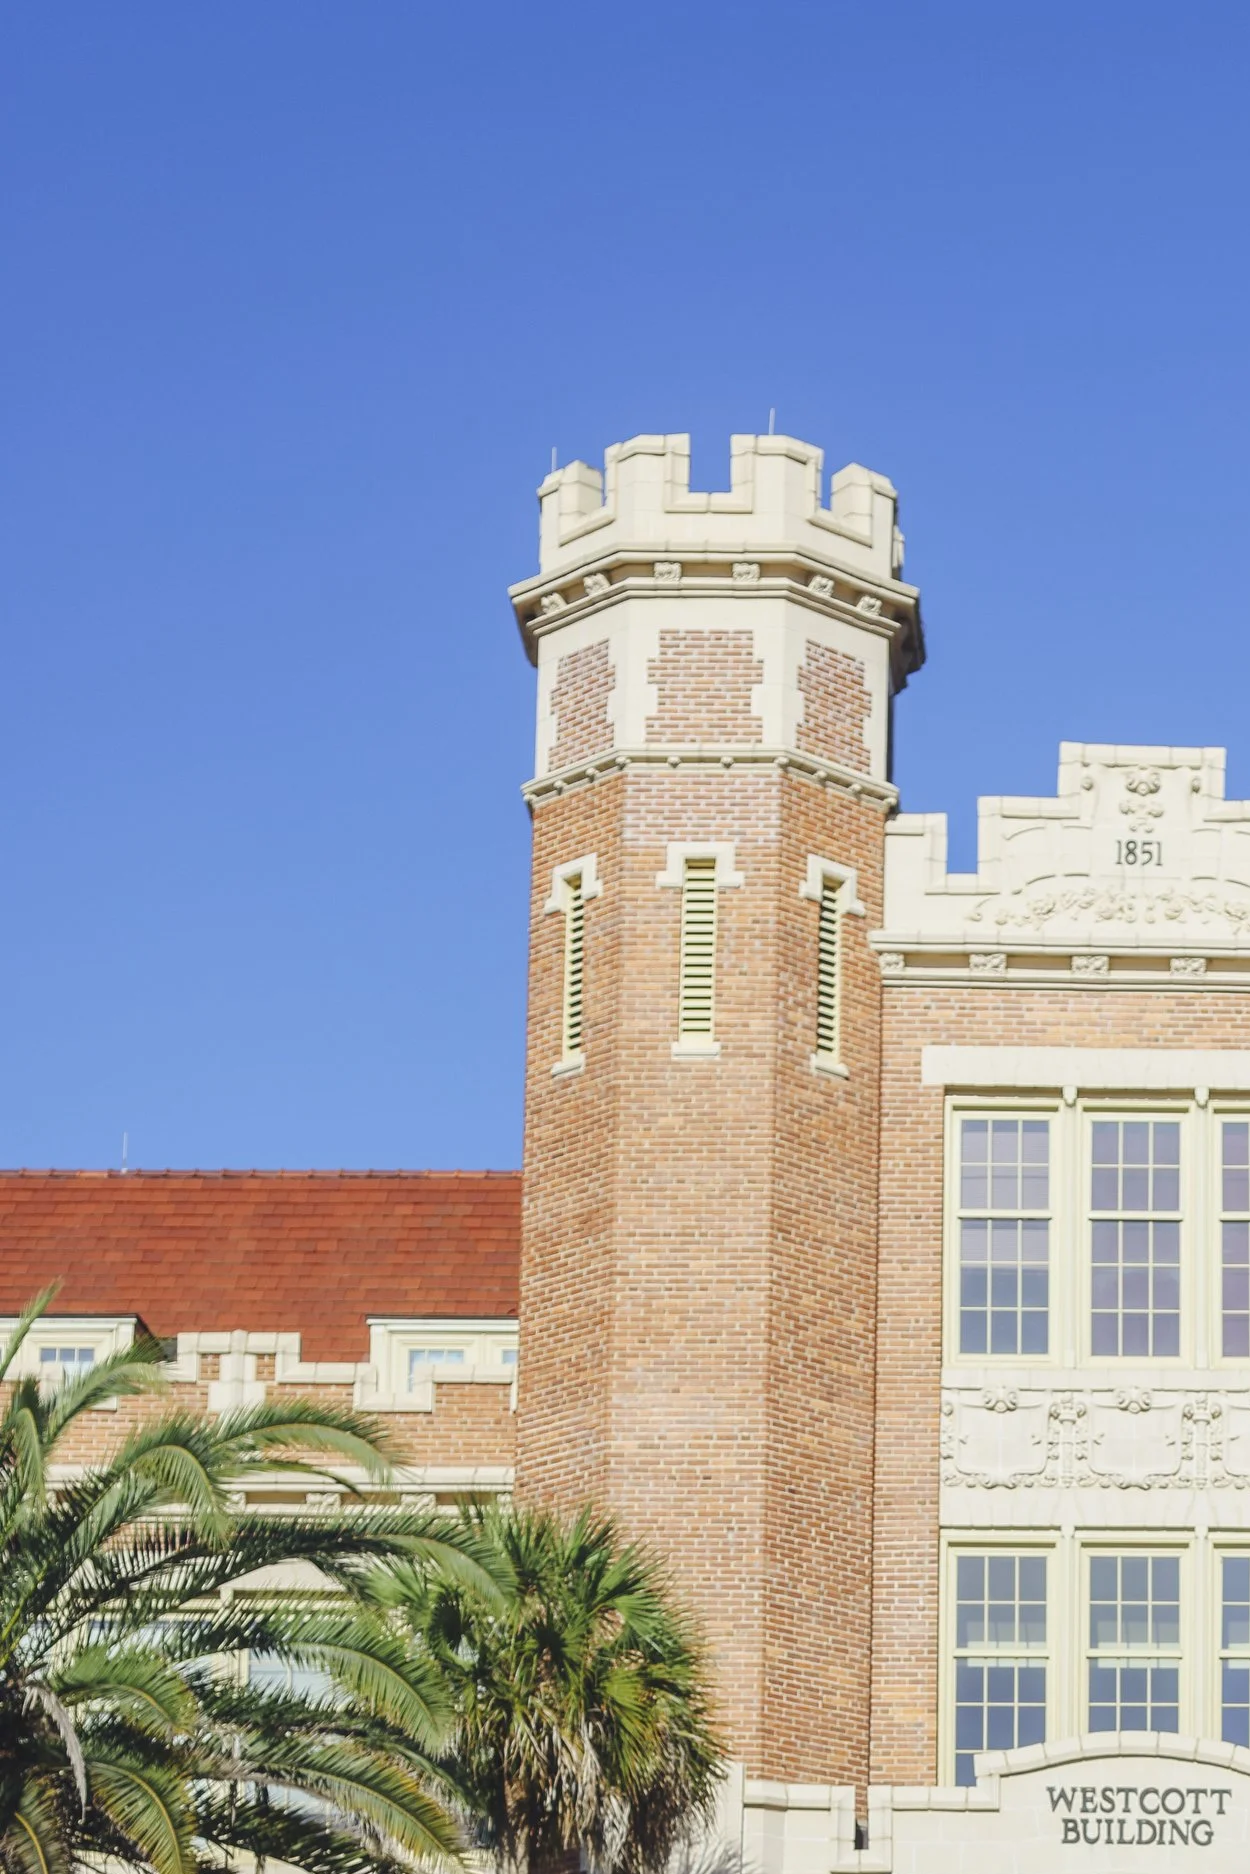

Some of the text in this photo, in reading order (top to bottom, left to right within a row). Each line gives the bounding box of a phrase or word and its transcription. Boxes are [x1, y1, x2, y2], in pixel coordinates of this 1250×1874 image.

[1115, 840, 1163, 866] 1851
[1046, 1786, 1232, 1815] WESTCOTT
[1061, 1818, 1214, 1846] BUILDING
